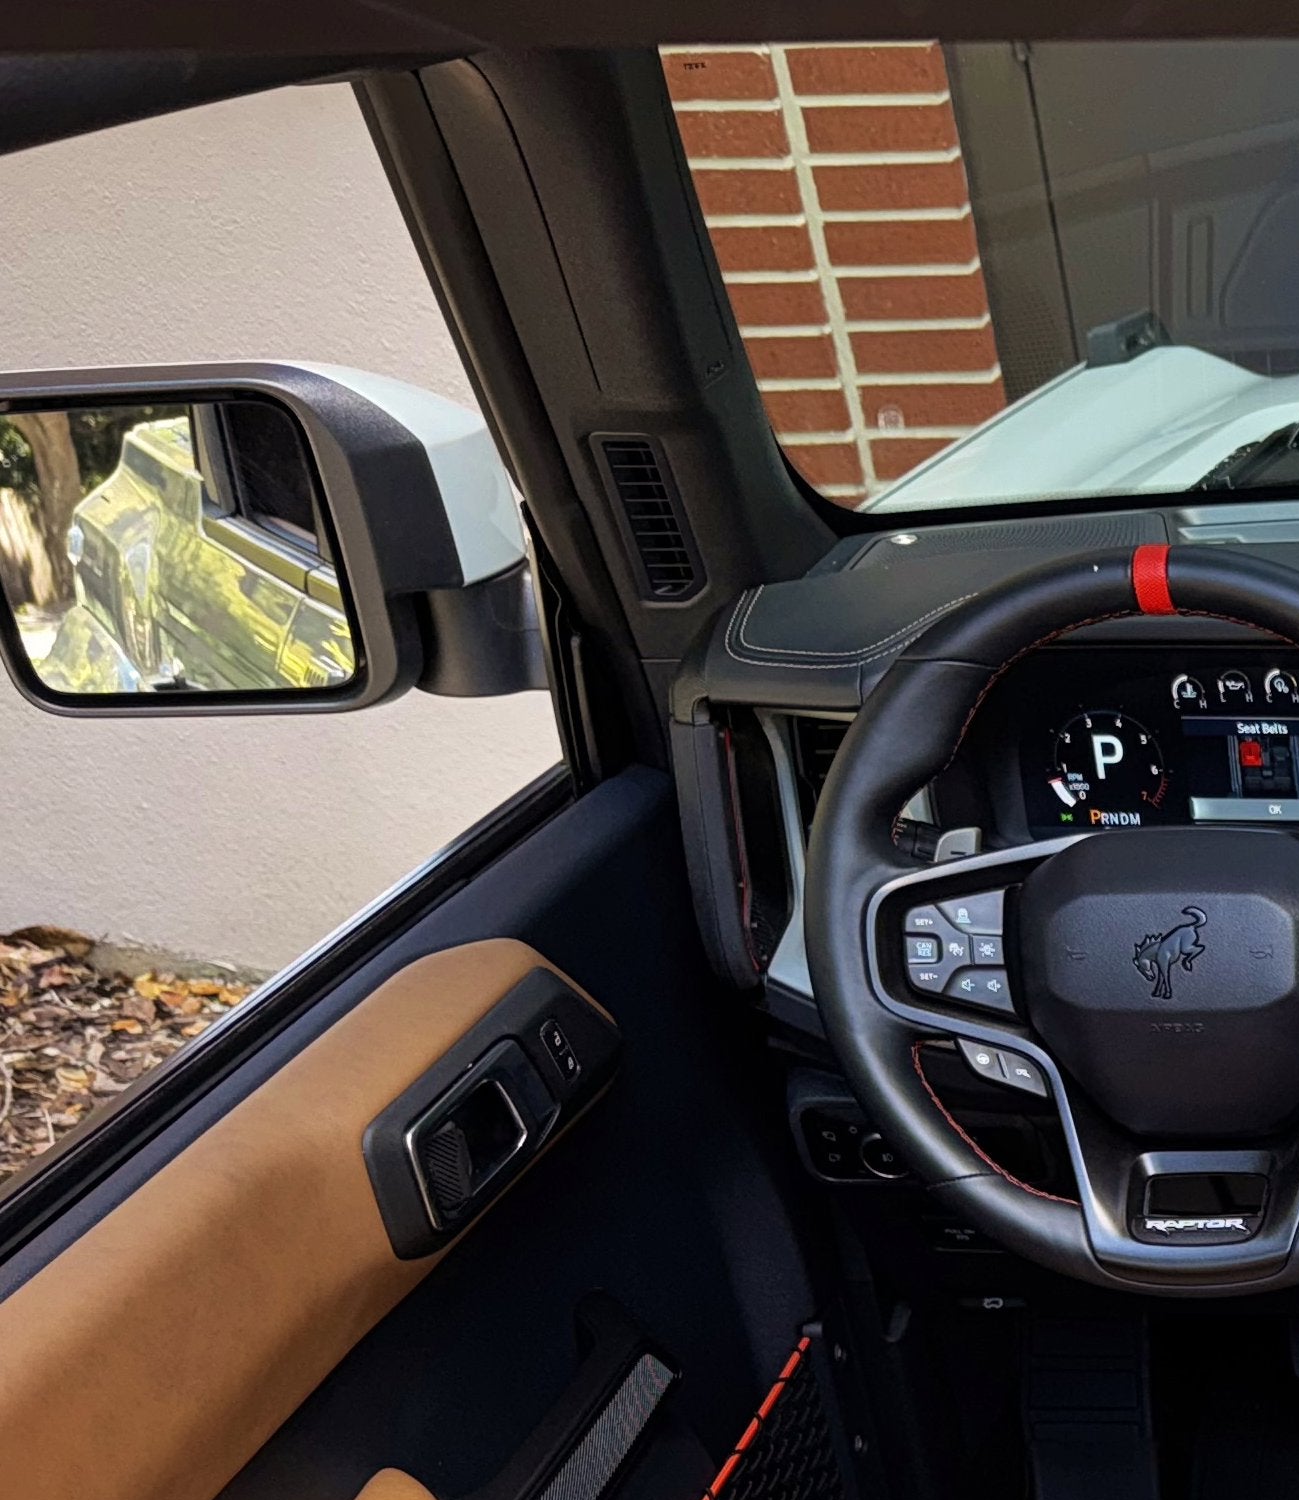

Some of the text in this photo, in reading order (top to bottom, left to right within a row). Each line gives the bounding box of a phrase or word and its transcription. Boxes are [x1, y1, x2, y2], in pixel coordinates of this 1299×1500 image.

[1246, 694, 1253, 702] H
[1291, 694, 1299, 703] H
[1174, 700, 1180, 709] C
[1199, 700, 1207, 709] H
[1086, 718, 1092, 728] 3
[1115, 718, 1122, 728] 4
[1237, 722, 1288, 734] Seat Belts
[1065, 733, 1071, 743] 2
[1140, 733, 1147, 744] 5
[1092, 734, 1123, 779] P
[1150, 764, 1158, 775] 6
[1067, 773, 1083, 781] RPM
[1079, 791, 1086, 800] 0
[1141, 791, 1148, 800] 7
[1268, 805, 1282, 815] OK
[1090, 809, 1141, 826] PRNDM
[1145, 1218, 1250, 1236] RAPTOR
